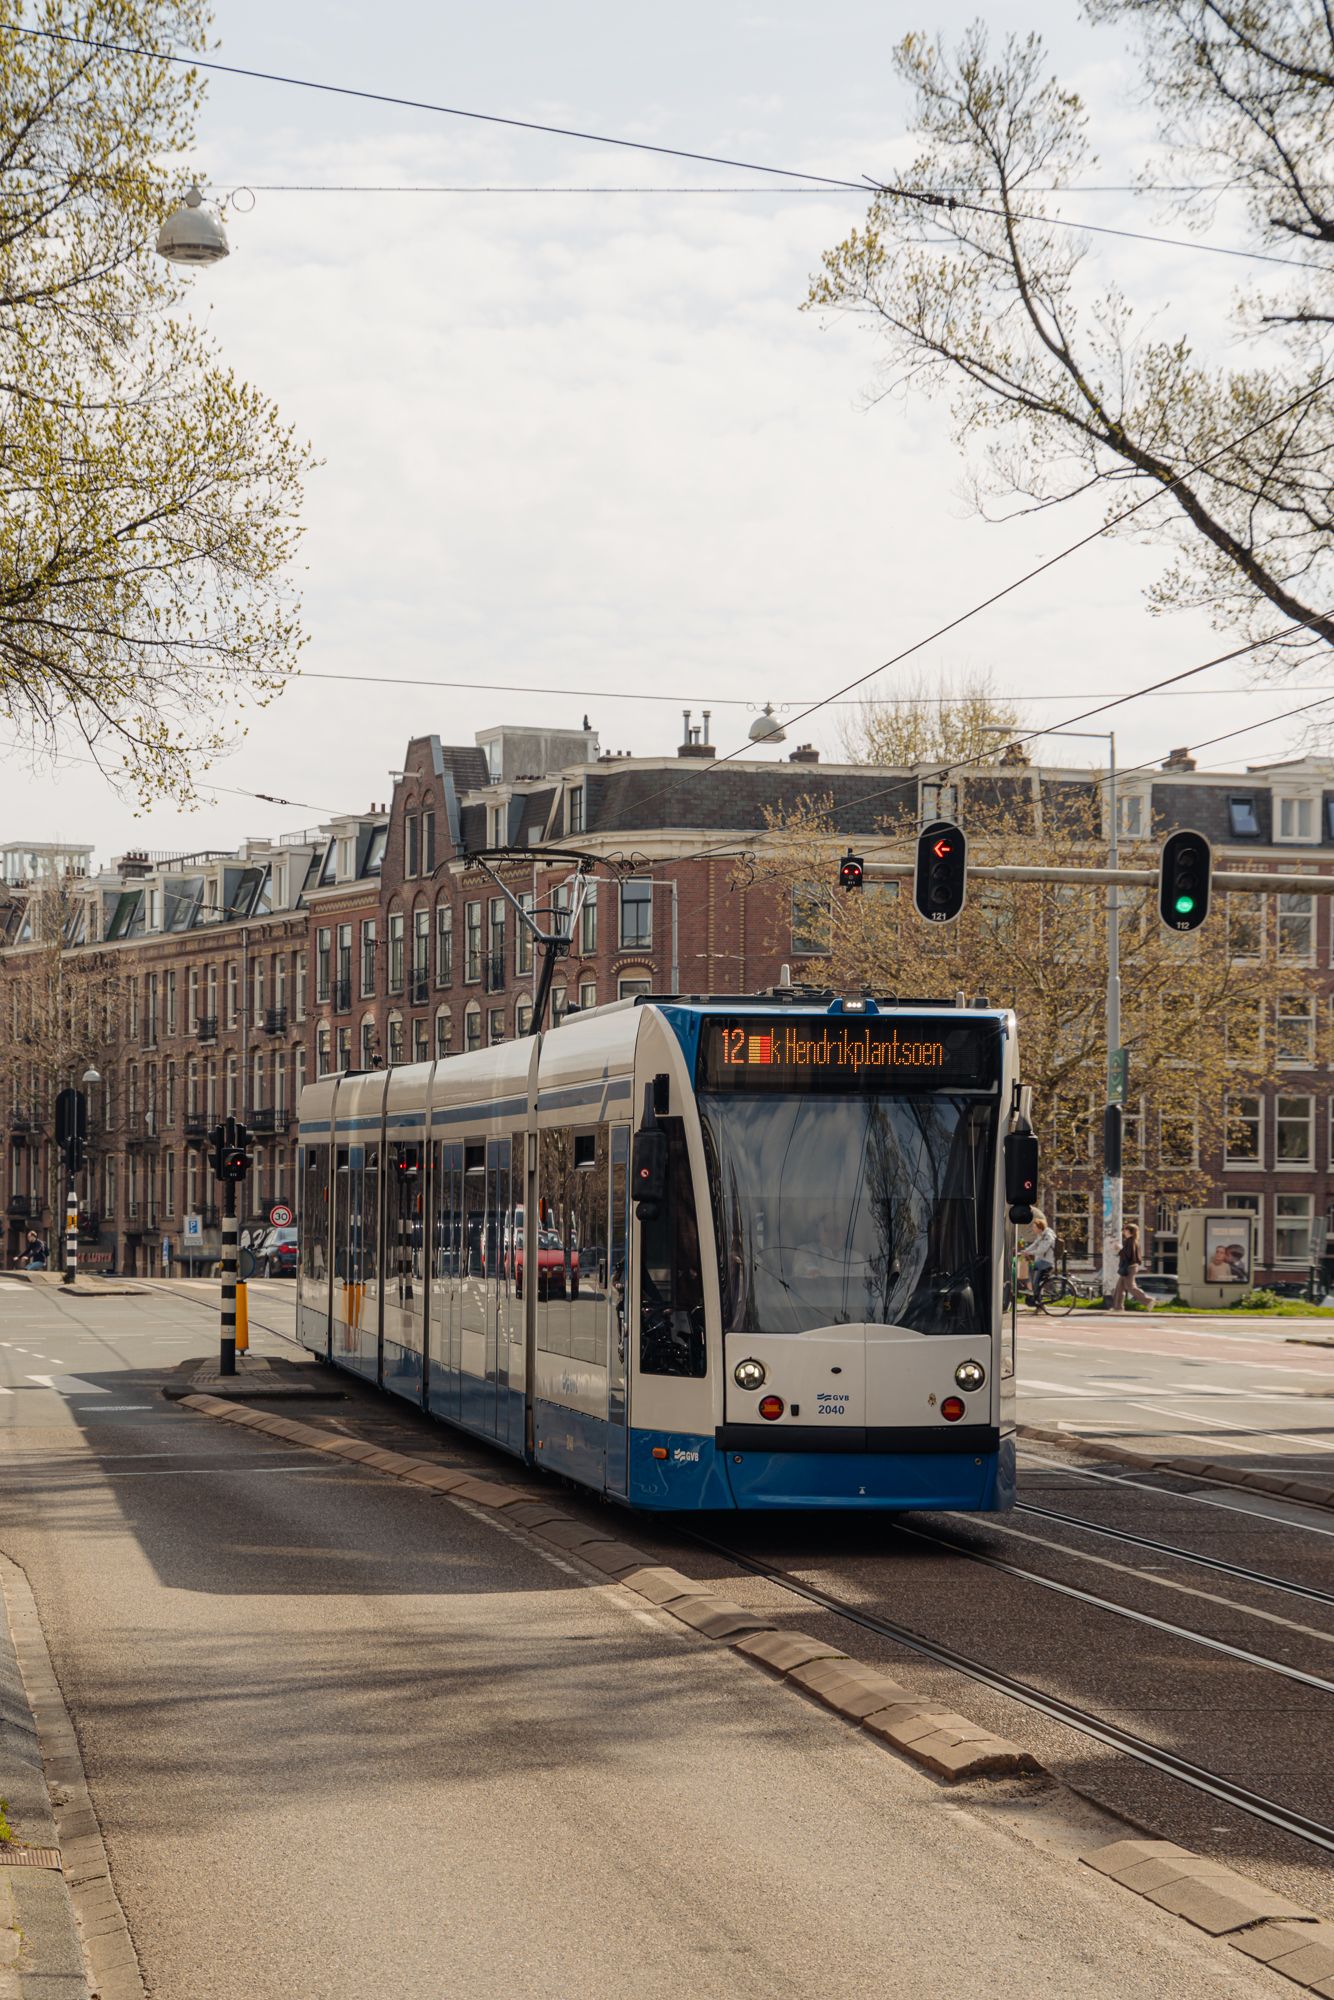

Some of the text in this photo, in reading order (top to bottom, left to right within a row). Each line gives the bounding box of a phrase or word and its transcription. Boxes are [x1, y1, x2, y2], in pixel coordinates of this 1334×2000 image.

[931, 912, 947, 920] 121
[1177, 921, 1190, 930] 112
[722, 1028, 944, 1073] 12 k Hendrikplantsoen
[274, 1212, 288, 1221] 30
[818, 1404, 845, 1415] 2040
[686, 1451, 699, 1462] GVB
